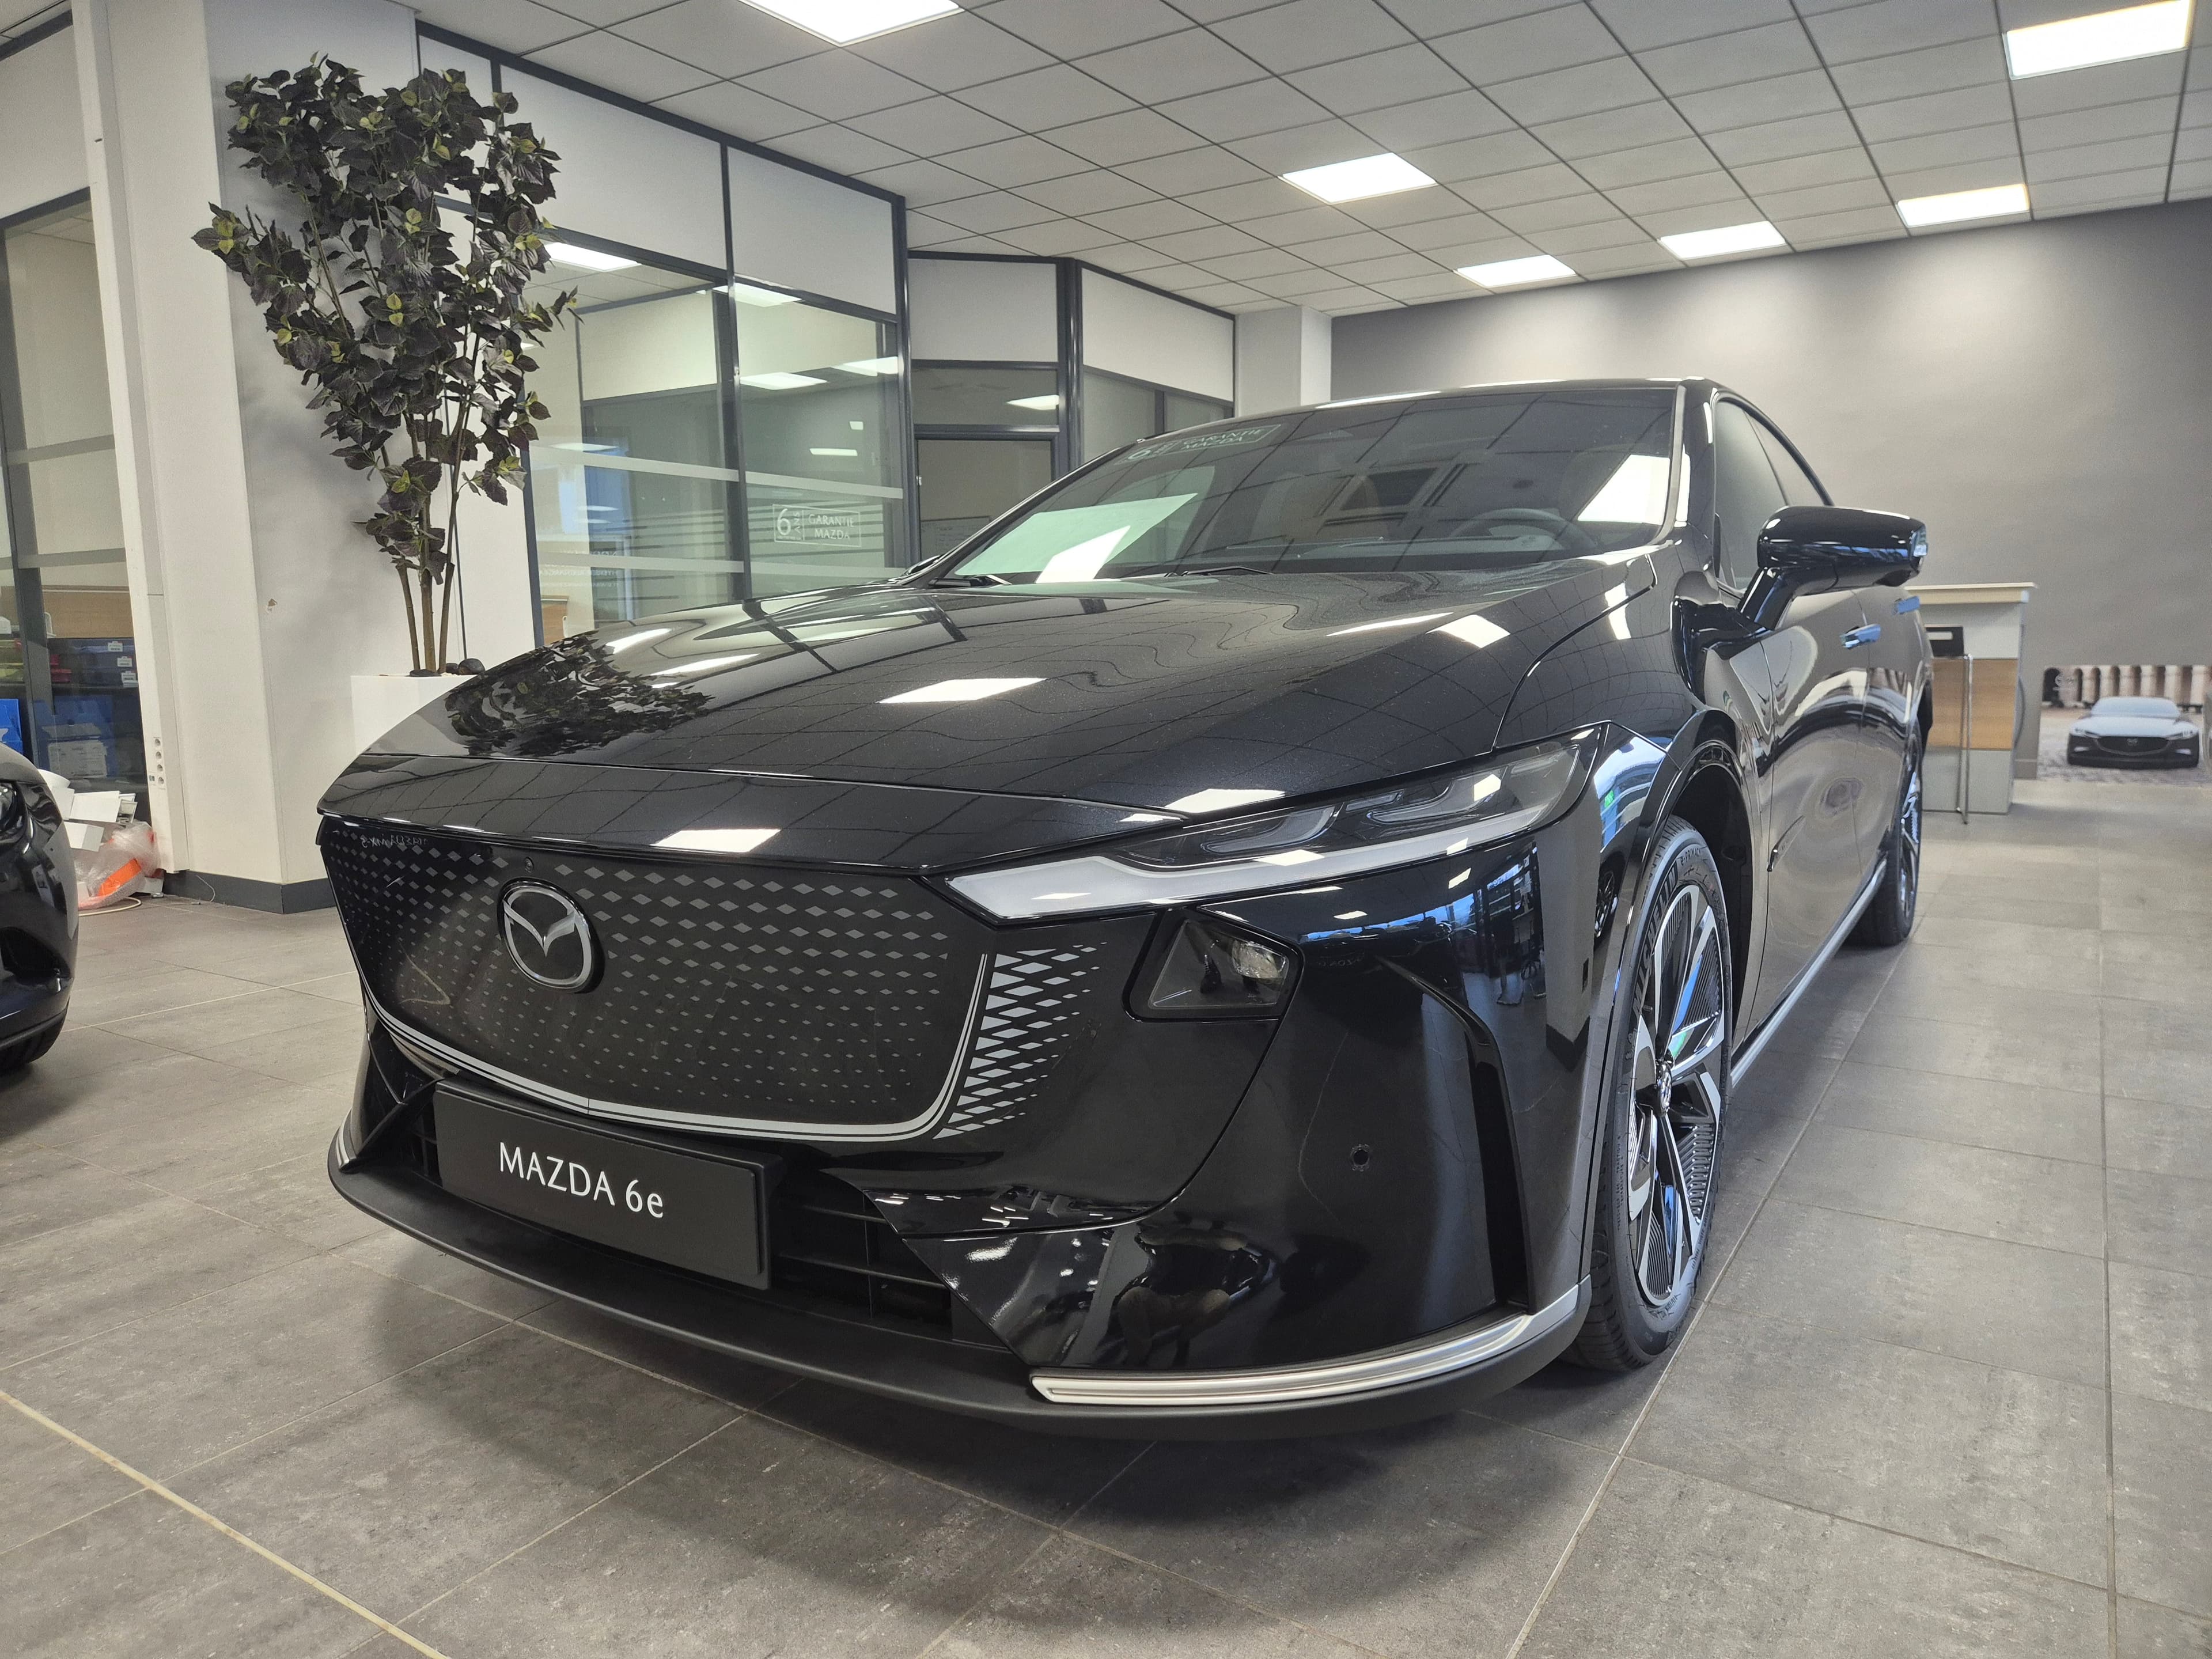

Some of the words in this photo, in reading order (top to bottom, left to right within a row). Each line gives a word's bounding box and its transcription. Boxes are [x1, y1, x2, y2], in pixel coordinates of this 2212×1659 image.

[777, 508, 791, 536] 6
[808, 514, 855, 528] GARANTIE
[815, 528, 850, 541] MAZDA
[1632, 858, 1678, 1025] MICHELIN
[499, 1142, 615, 1206] MAZDA
[626, 1179, 664, 1218] 6e
